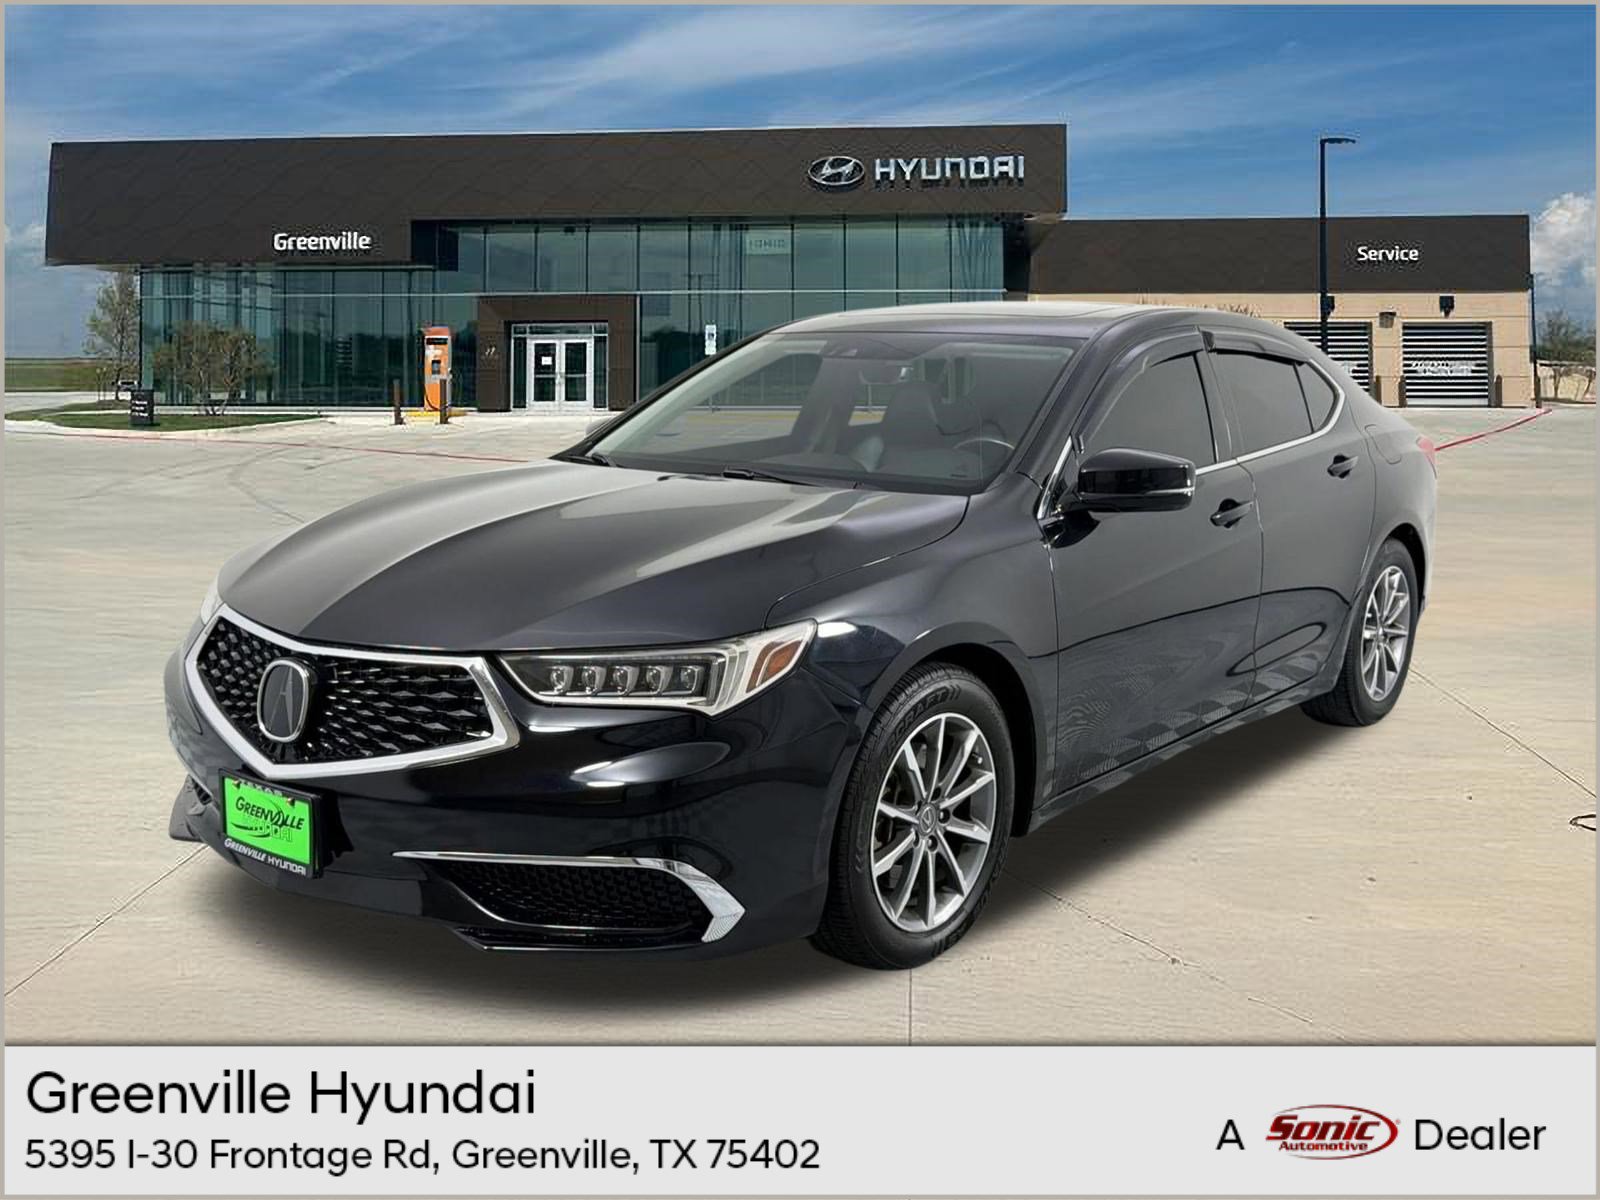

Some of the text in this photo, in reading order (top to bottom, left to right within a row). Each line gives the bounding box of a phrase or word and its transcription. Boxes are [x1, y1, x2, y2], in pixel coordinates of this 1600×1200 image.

[874, 156, 1024, 181] HYUNDAI
[274, 231, 372, 250] Greenville
[1357, 245, 1419, 261] Service
[224, 837, 307, 876] GREENVILLE HYUNDAI
